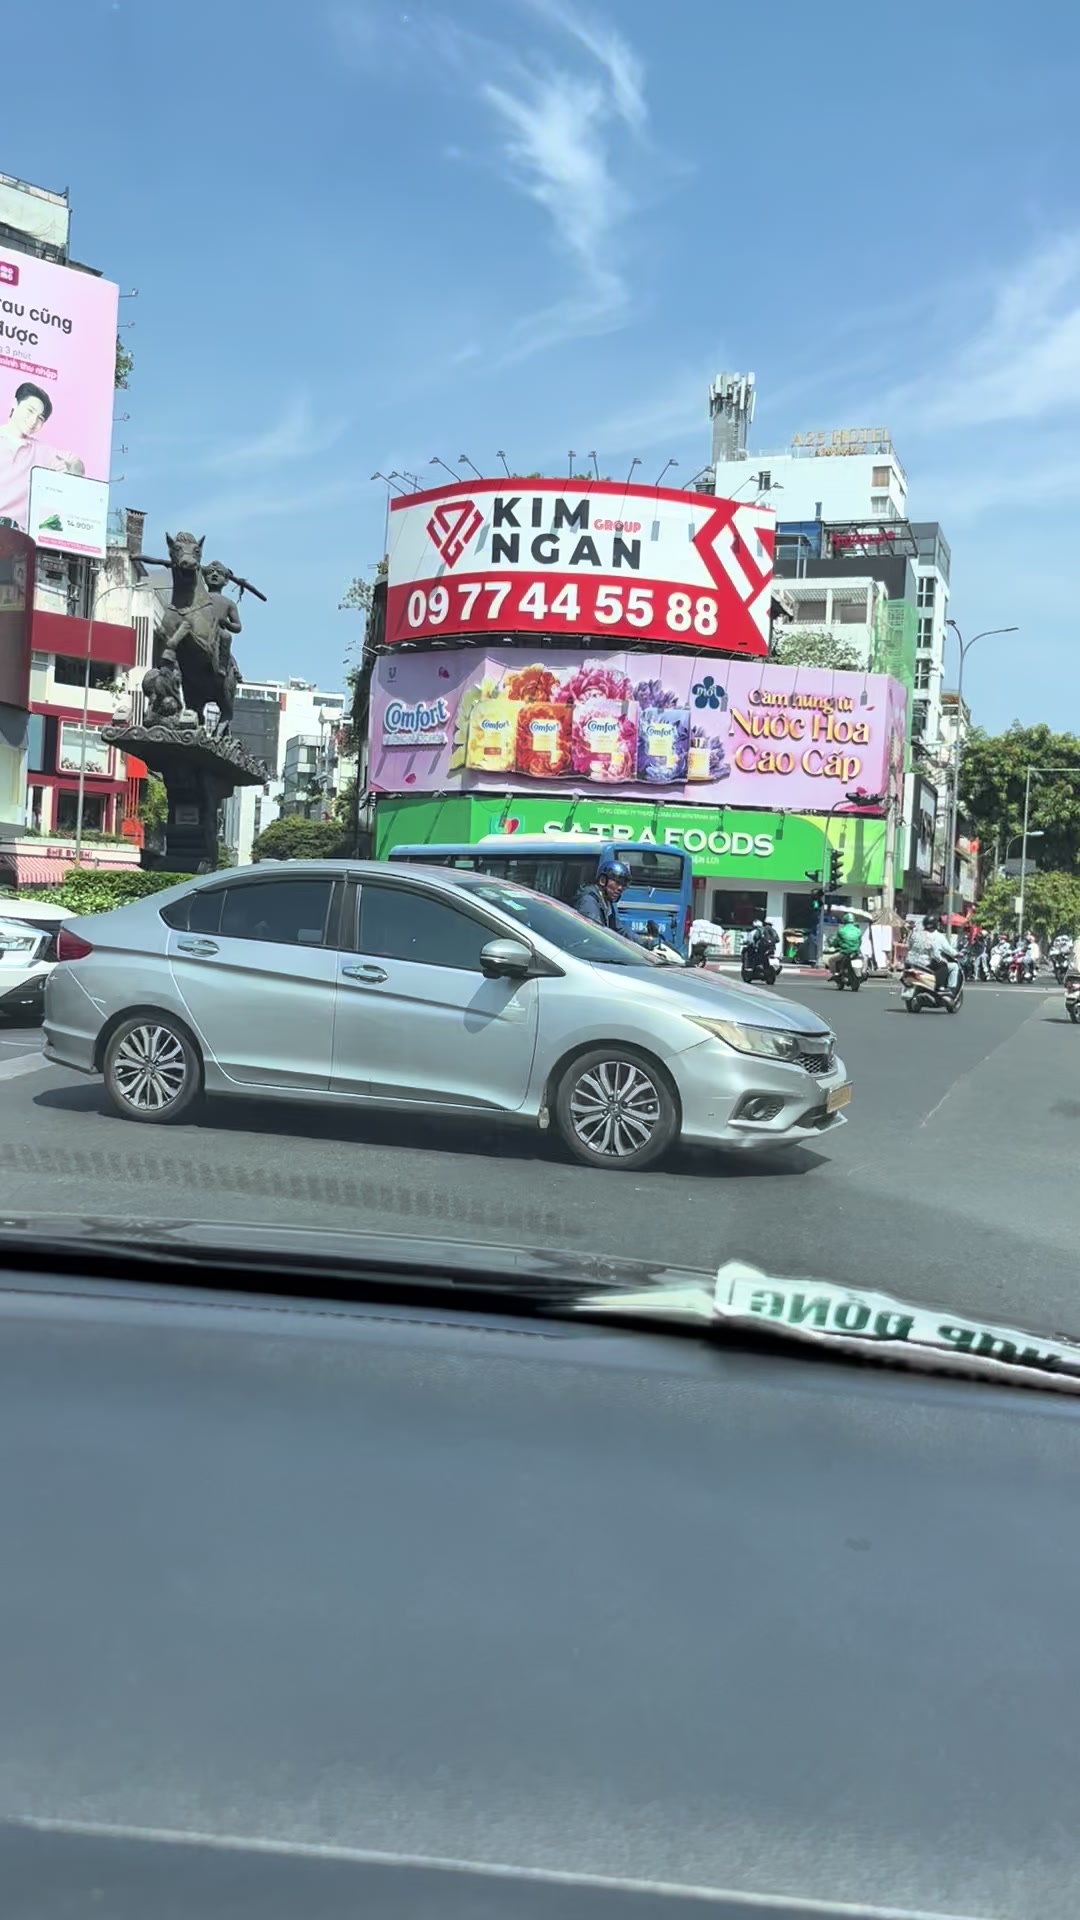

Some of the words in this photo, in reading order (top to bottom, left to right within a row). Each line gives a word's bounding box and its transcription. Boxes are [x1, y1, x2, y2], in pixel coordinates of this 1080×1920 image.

[0, 299, 25, 316] au
[29, 308, 73, 334] cũng
[832, 427, 890, 445] HOTEL
[493, 497, 590, 530] KIM
[593, 518, 642, 533] GROUP
[491, 533, 641, 570] NGAN
[407, 590, 449, 628] 09
[458, 581, 512, 619] 77
[518, 582, 581, 621] 44
[594, 586, 654, 628] 55
[666, 593, 718, 636] 88
[385, 699, 449, 732] Comfort
[481, 719, 509, 730] Comfort
[530, 721, 559, 732] Comfort
[587, 720, 620, 732] Comfort
[646, 725, 675, 736] Comfort
[812, 714, 869, 745] Hoa
[735, 743, 795, 775] Cao
[801, 748, 861, 784] Cấp
